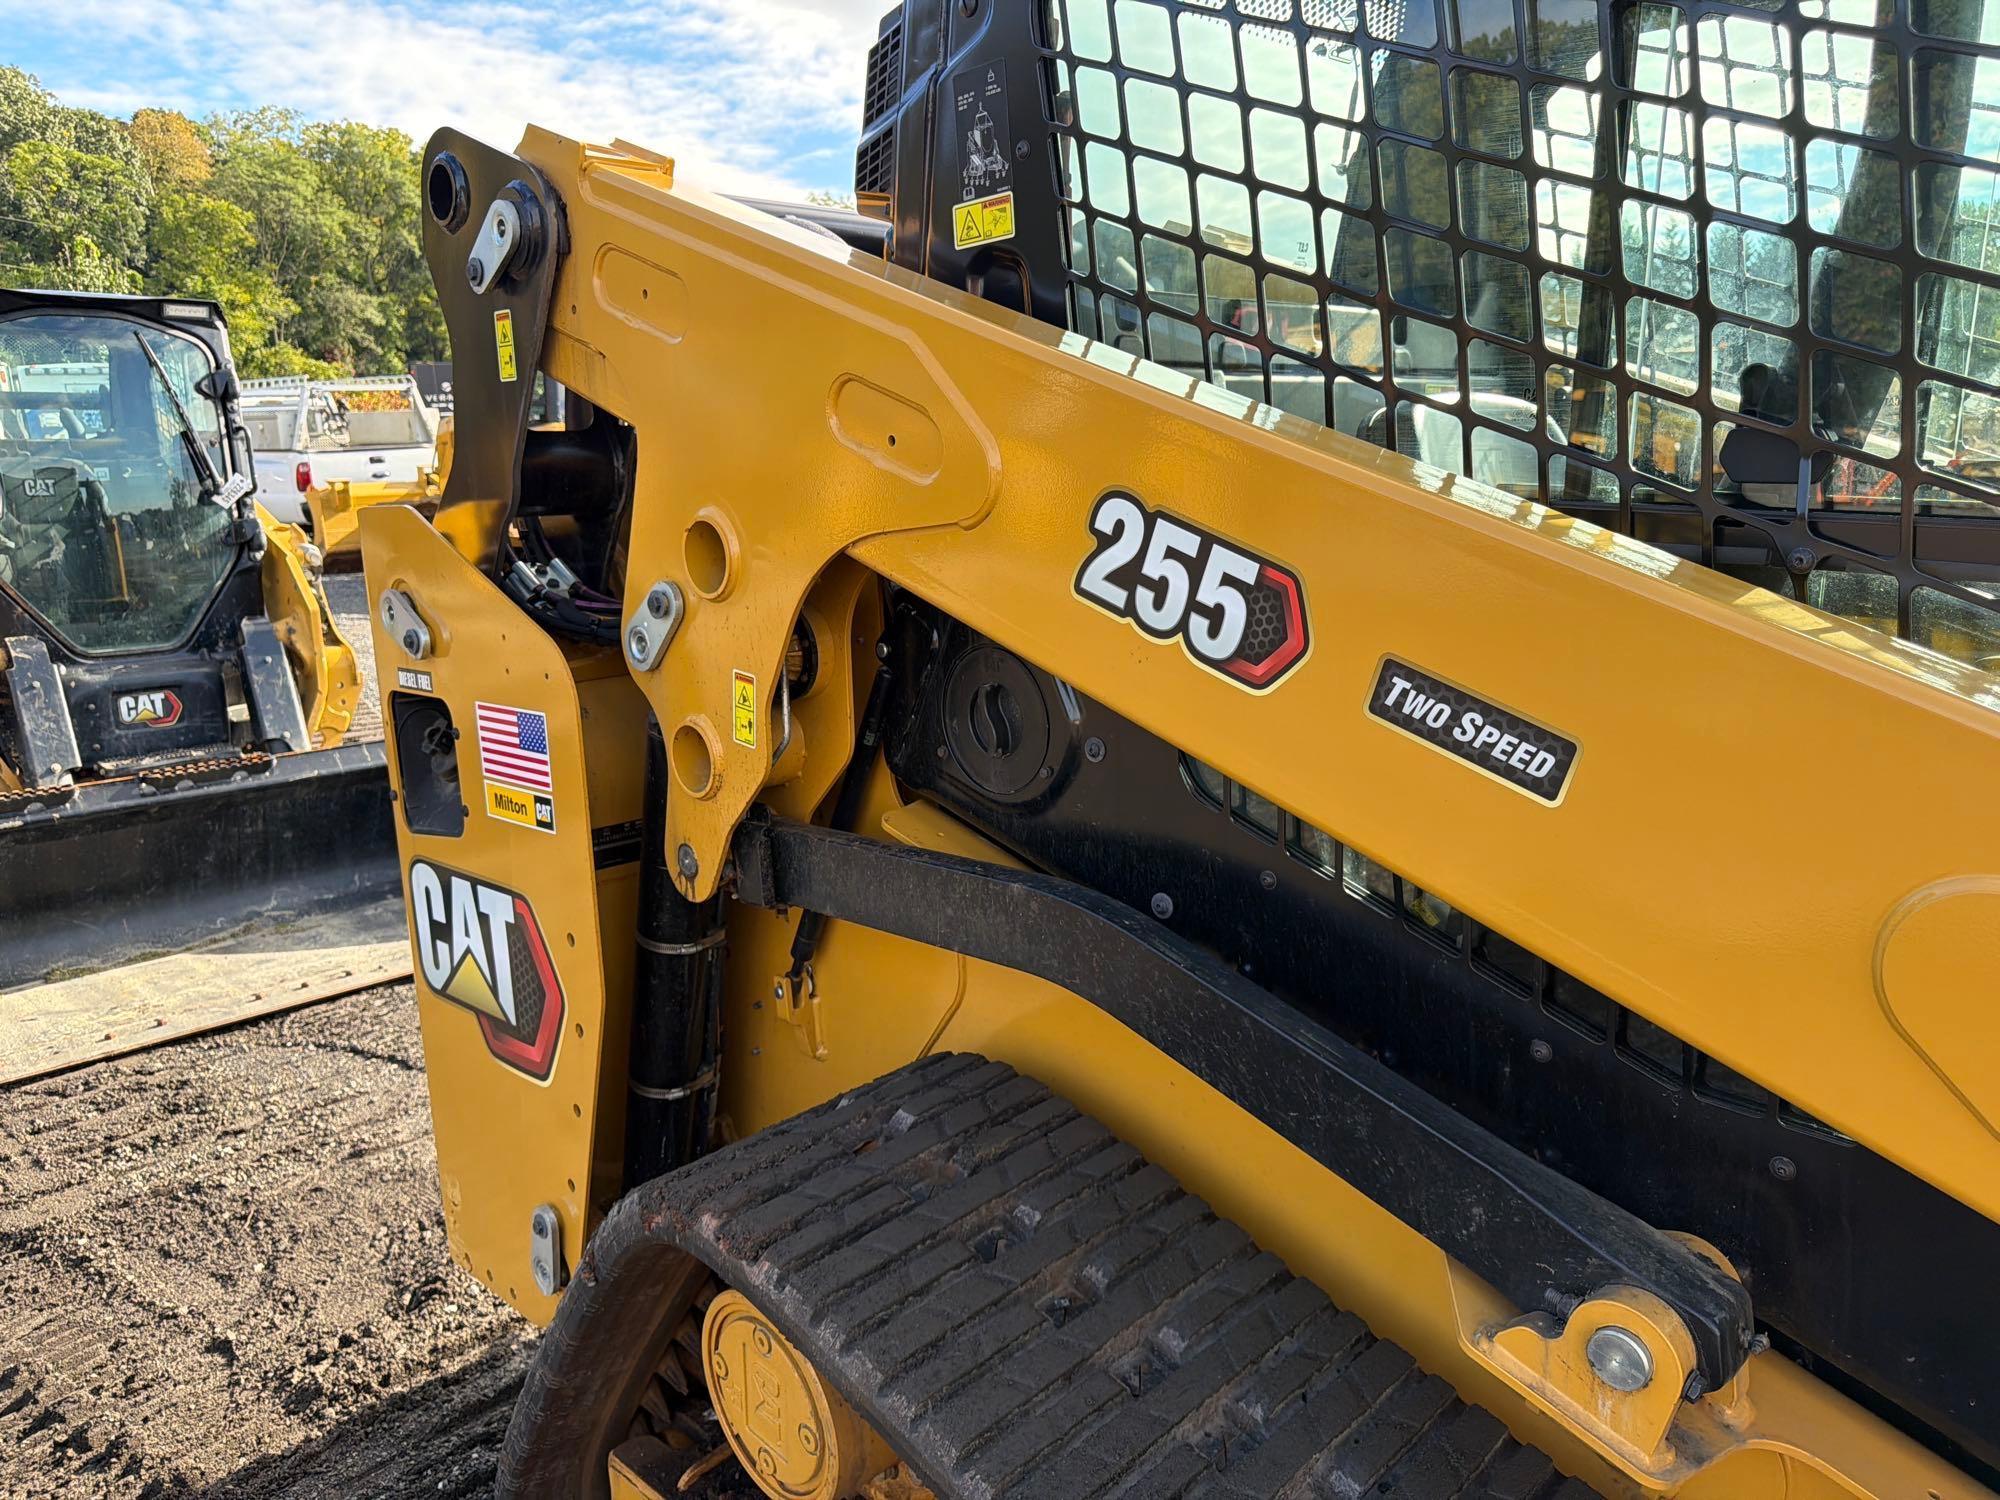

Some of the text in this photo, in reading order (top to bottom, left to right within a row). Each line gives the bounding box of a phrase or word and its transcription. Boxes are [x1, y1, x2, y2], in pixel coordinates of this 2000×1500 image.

[24, 478, 55, 496] CAT
[1079, 497, 1261, 661] 255
[398, 670, 433, 691] DIESEL FUEL
[119, 692, 165, 723] CAT
[494, 792, 551, 823] Milton CAT
[411, 862, 517, 1027] CAT
